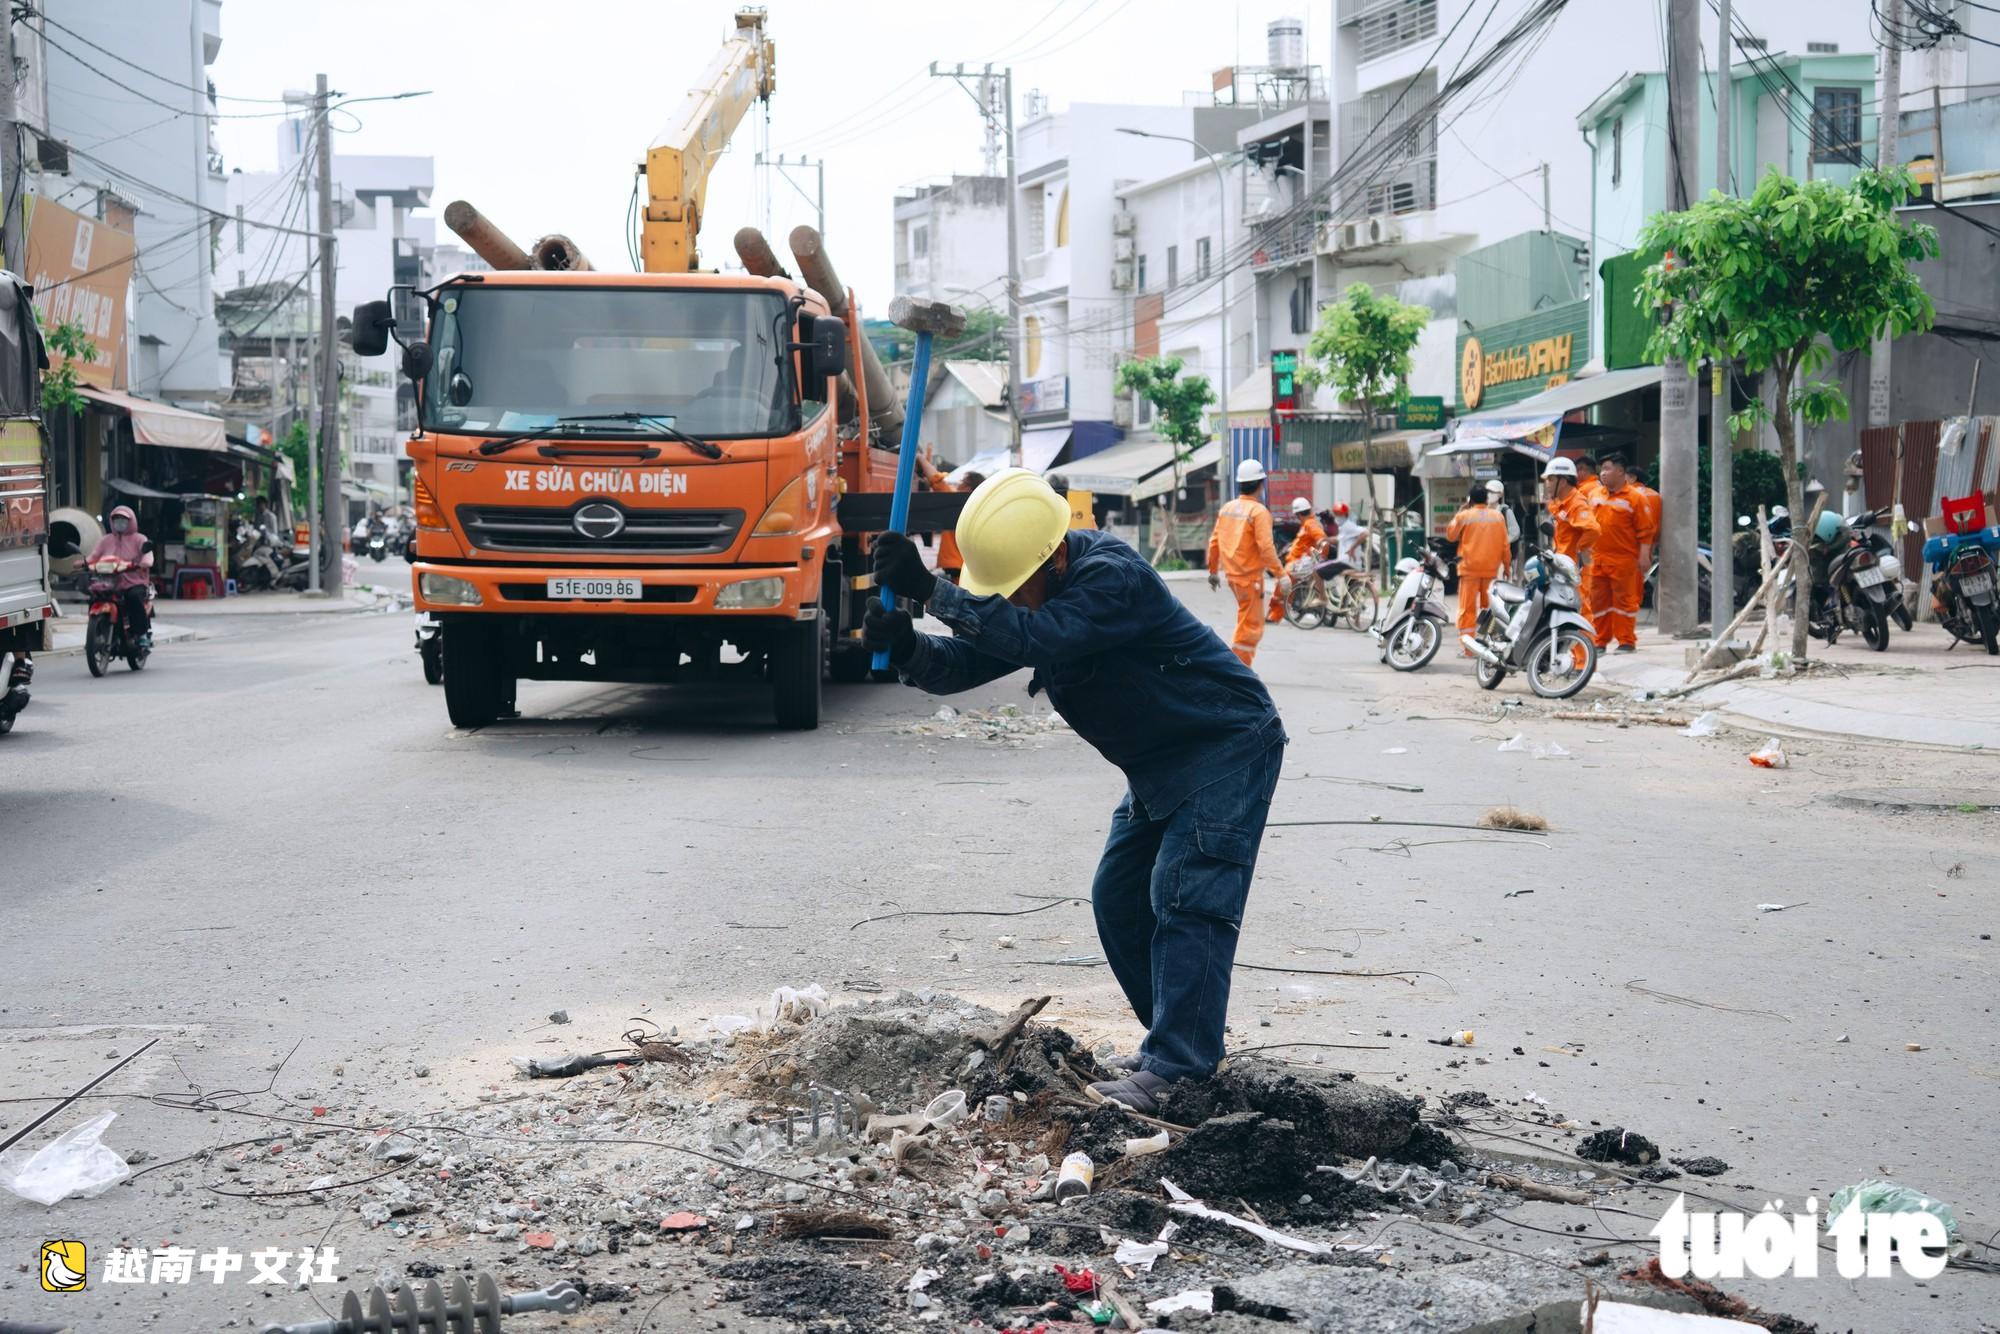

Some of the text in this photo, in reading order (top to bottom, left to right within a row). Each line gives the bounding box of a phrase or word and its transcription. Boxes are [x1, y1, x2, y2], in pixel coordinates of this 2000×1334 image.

[1527, 334, 1573, 376] XANH
[504, 465, 687, 497] XE SỬA CHỮA ĐIỆN
[555, 582, 634, 596] 51E-009.86
